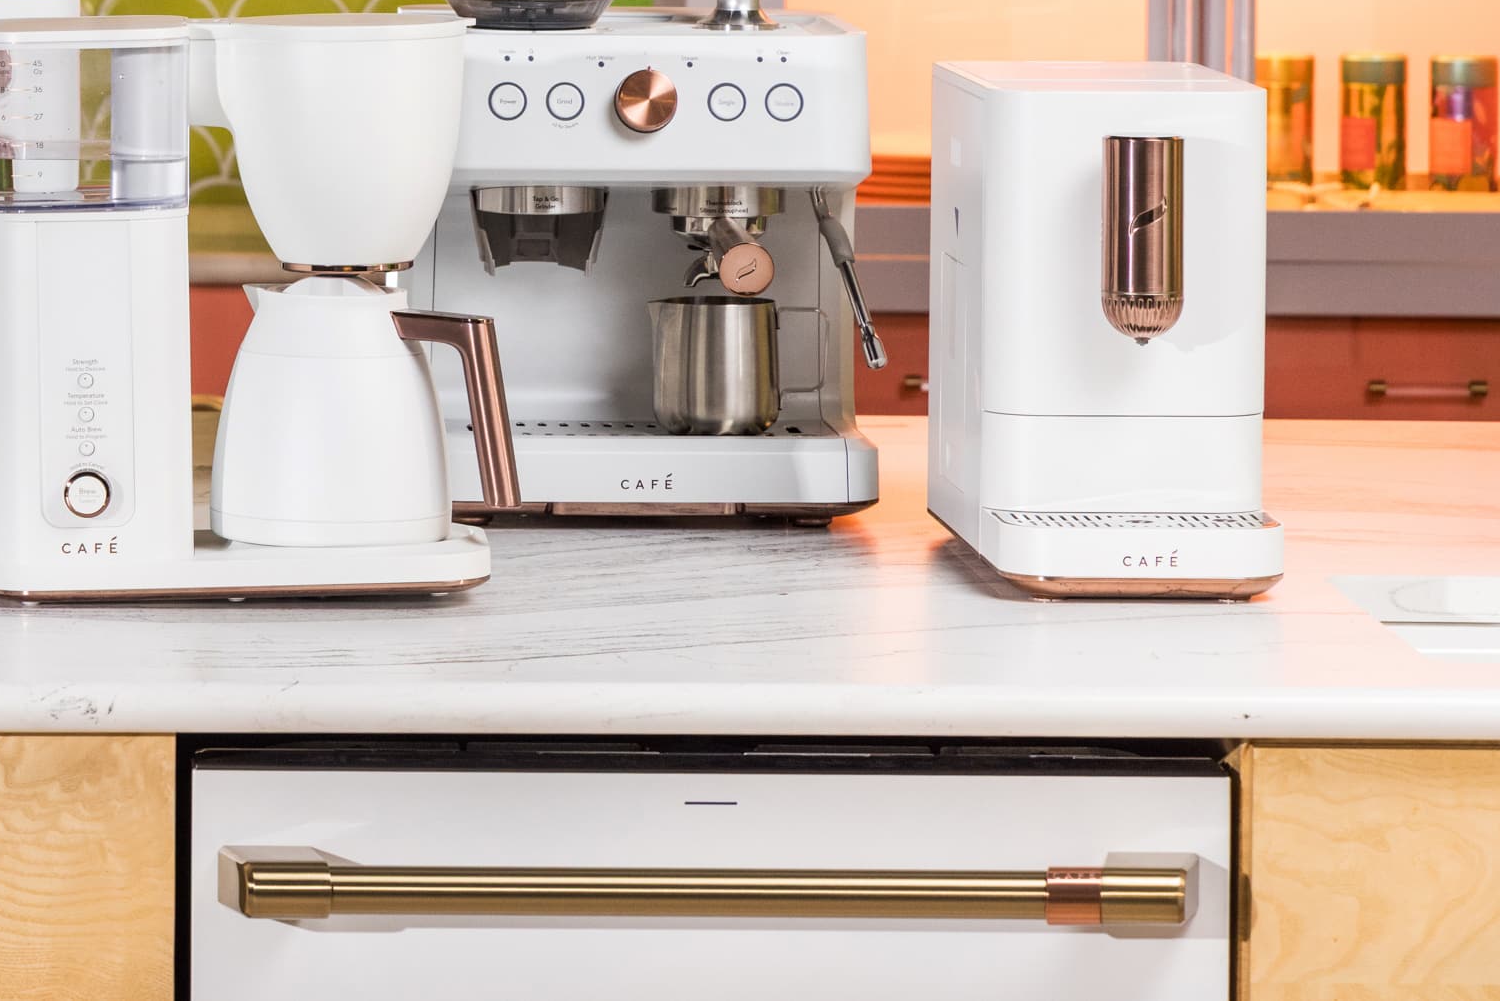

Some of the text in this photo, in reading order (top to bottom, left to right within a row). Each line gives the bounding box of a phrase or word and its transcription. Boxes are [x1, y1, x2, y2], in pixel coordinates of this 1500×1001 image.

[620, 473, 673, 490] CAFÉ
[61, 536, 118, 554] CAFÉ
[1122, 549, 1179, 567] CAFÉ
